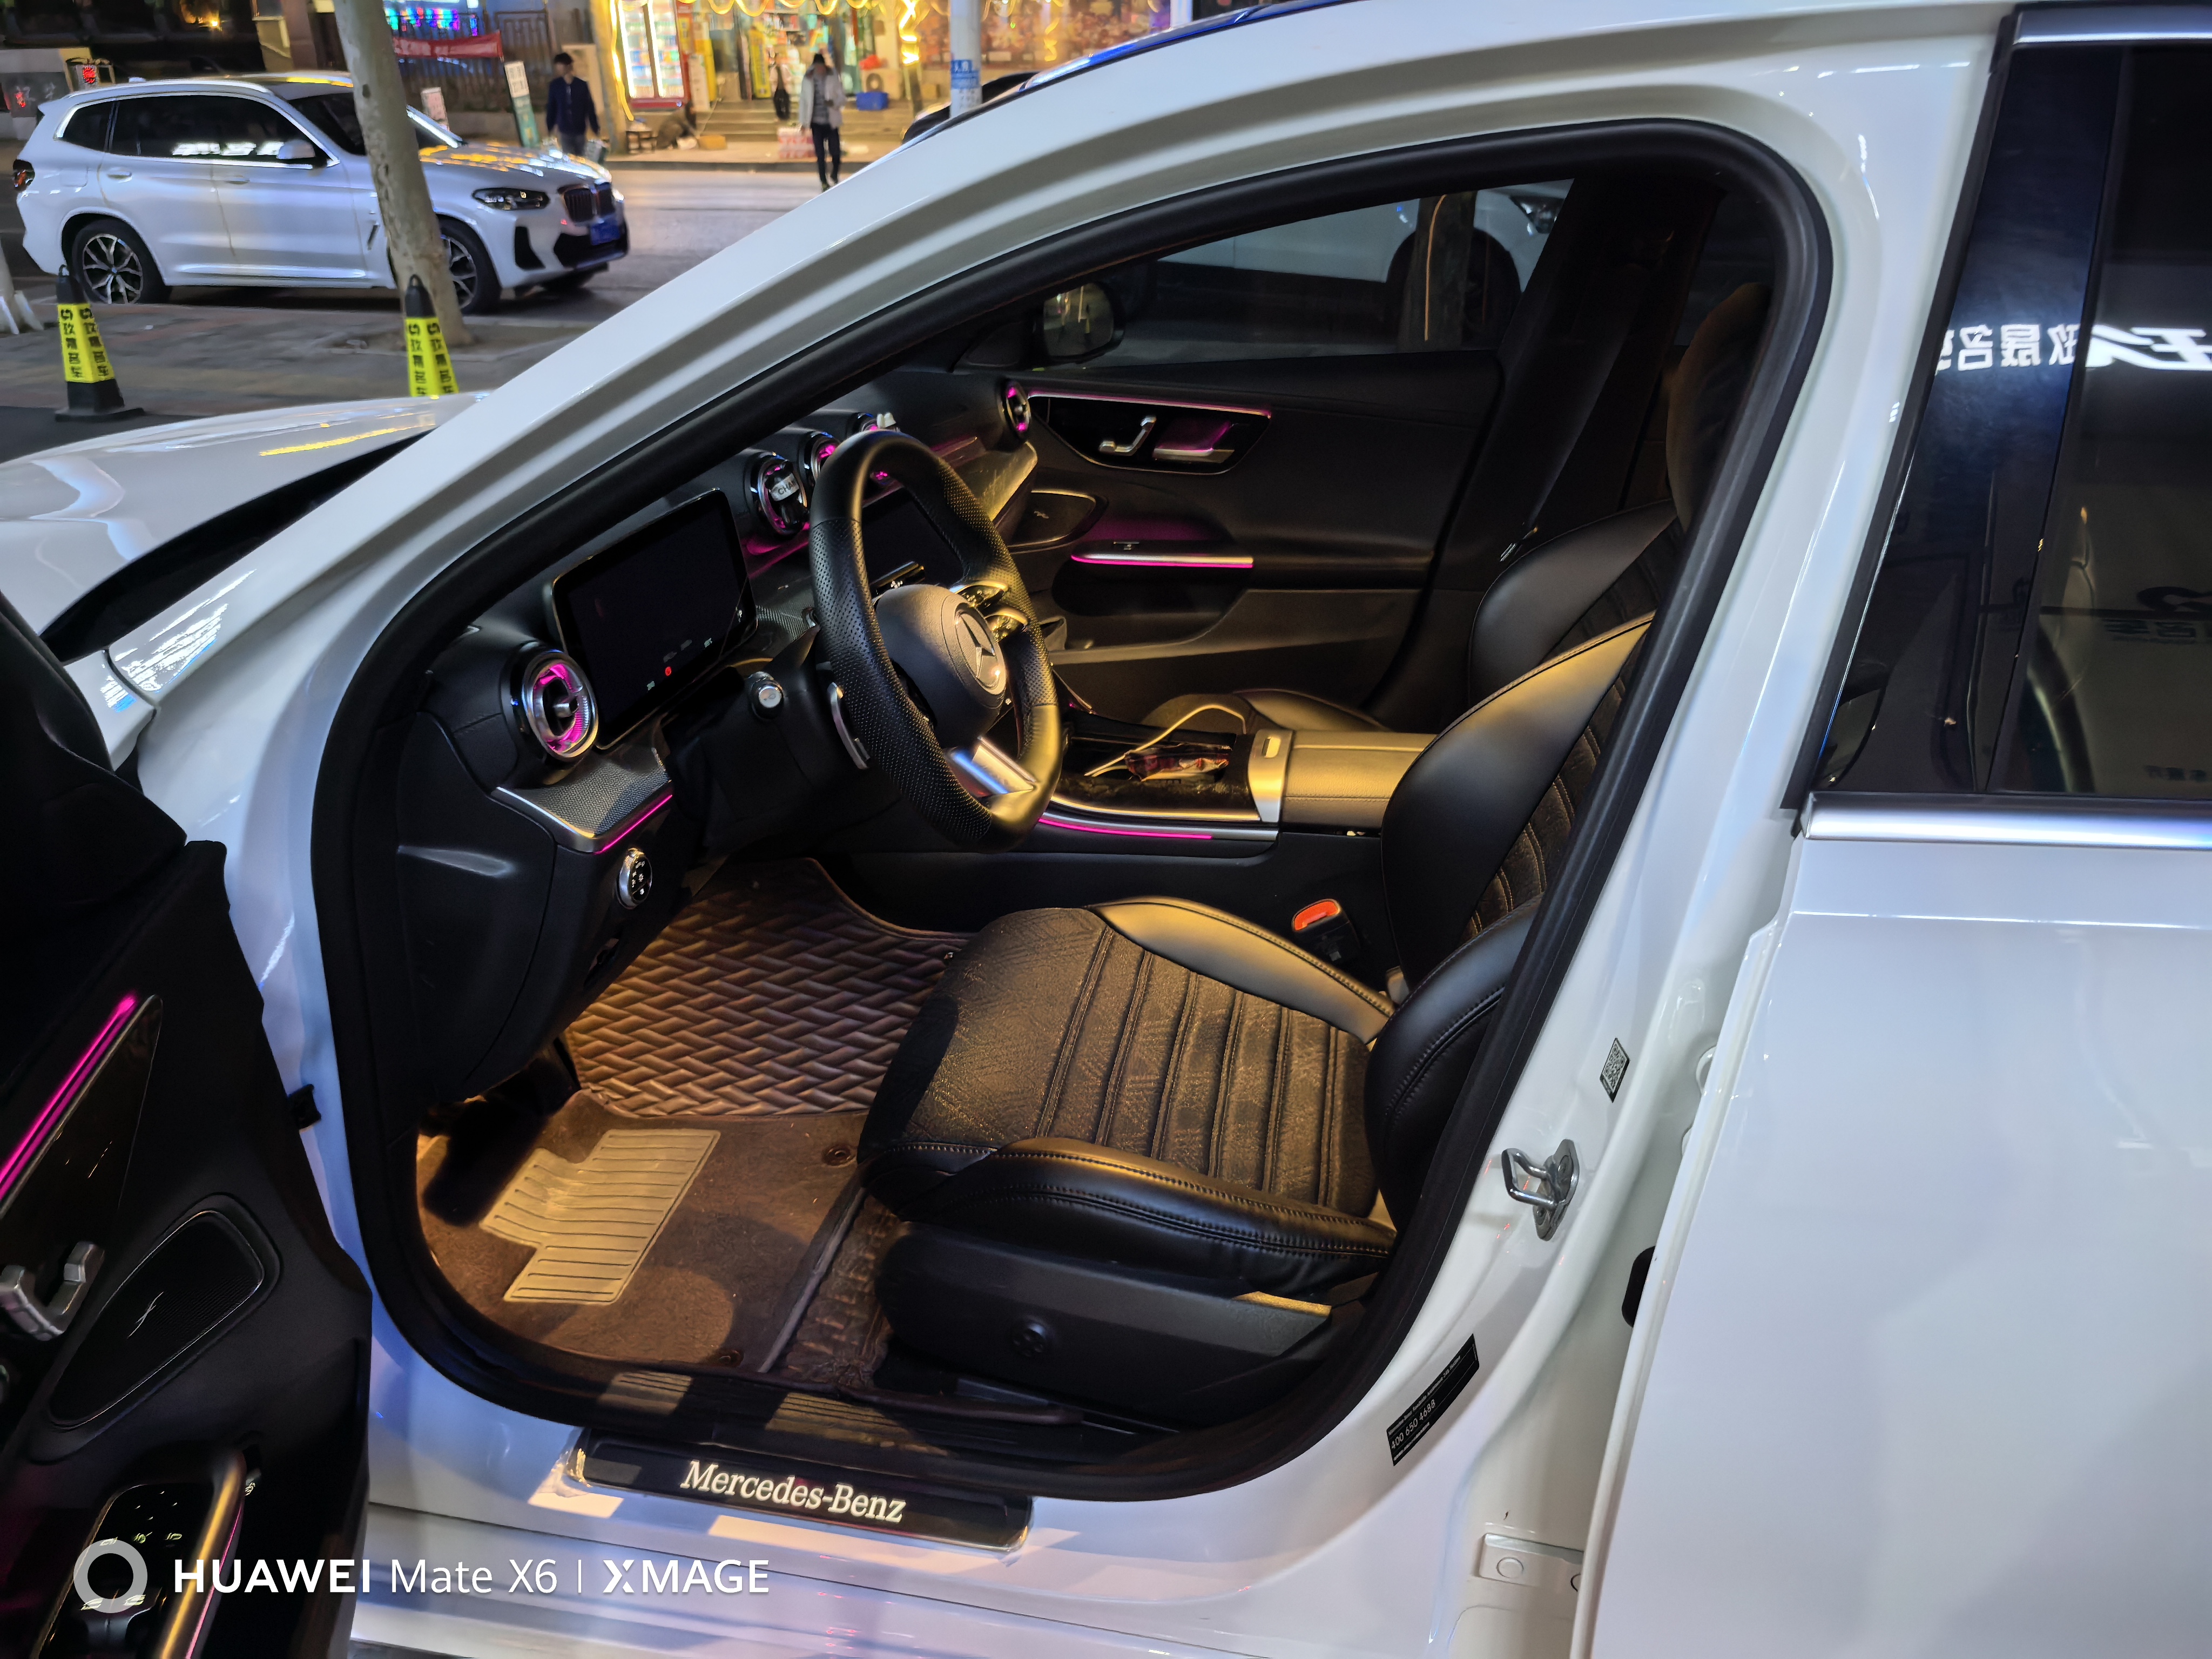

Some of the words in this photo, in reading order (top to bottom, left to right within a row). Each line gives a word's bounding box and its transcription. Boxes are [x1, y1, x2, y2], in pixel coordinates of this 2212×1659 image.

[1391, 1432, 1404, 1449] 400
[1405, 1418, 1418, 1436] 650
[1419, 1399, 1436, 1420] 4688
[679, 1459, 907, 1523] Mercedes-Benz
